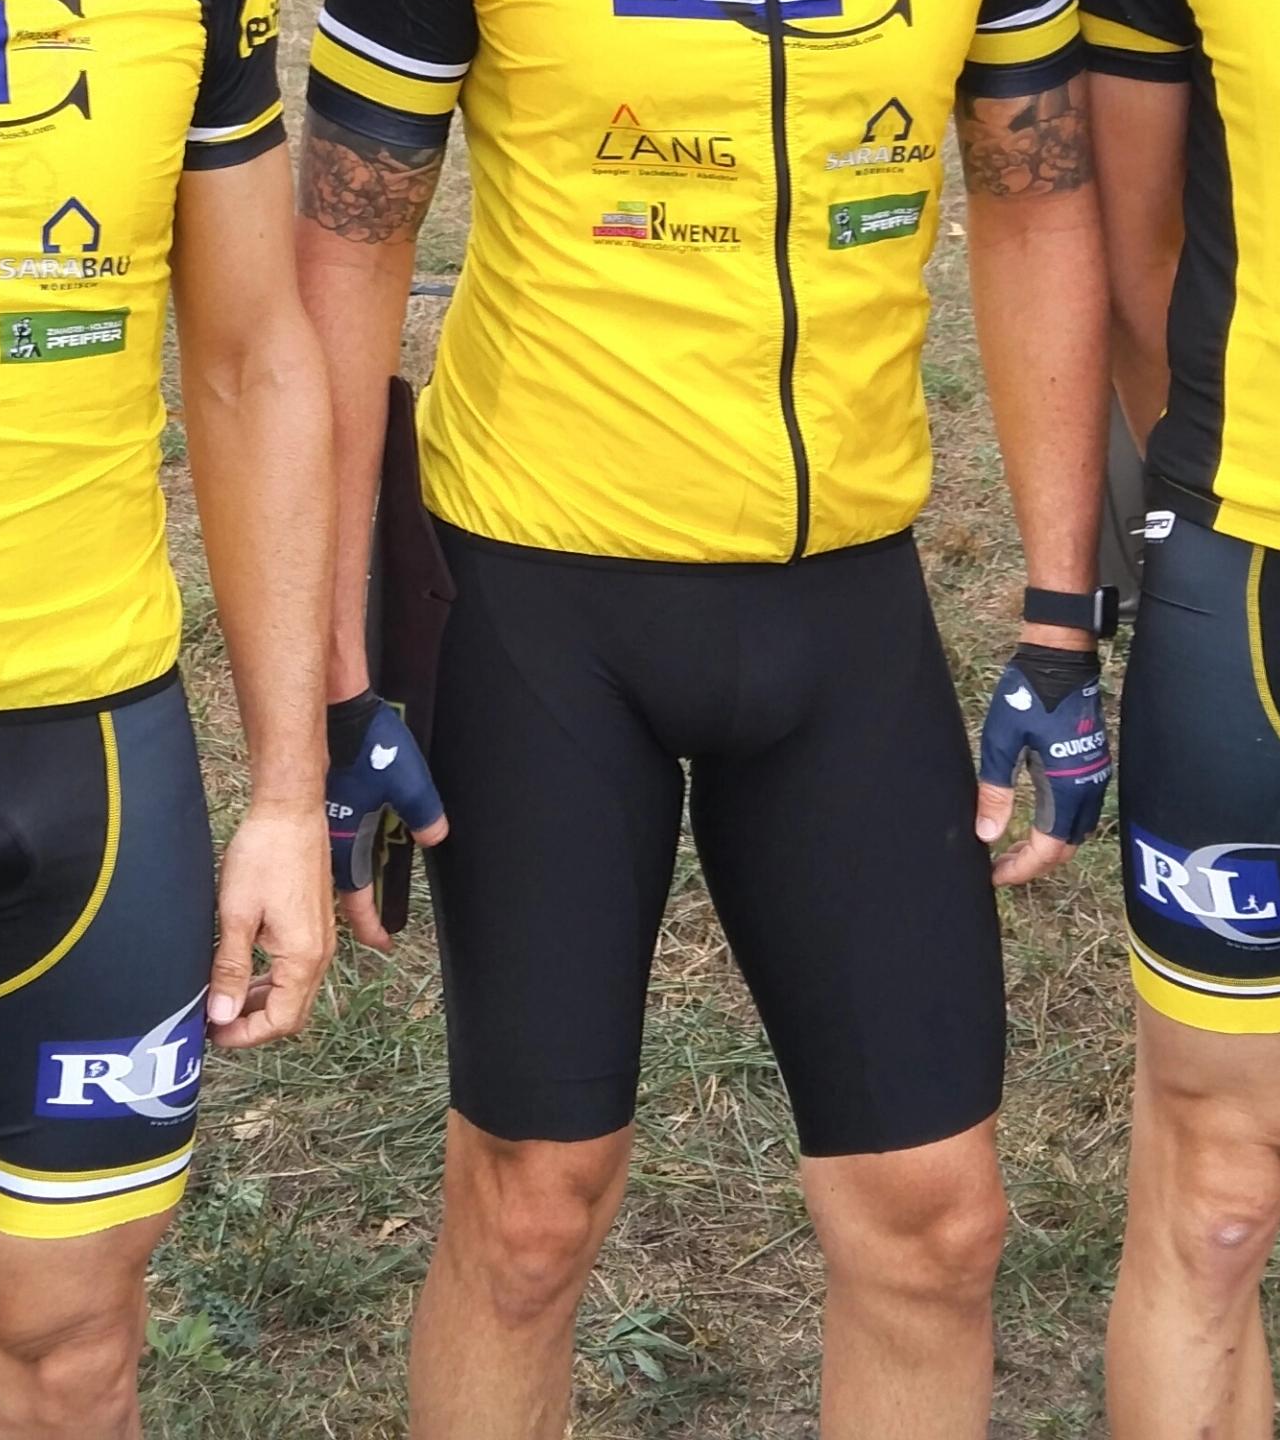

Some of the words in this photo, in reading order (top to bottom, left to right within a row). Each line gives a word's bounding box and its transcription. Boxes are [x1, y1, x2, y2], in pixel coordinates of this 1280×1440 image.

[595, 131, 737, 168] LANG
[669, 223, 742, 244] WENZL
[46, 328, 123, 350] PFEIFFER
